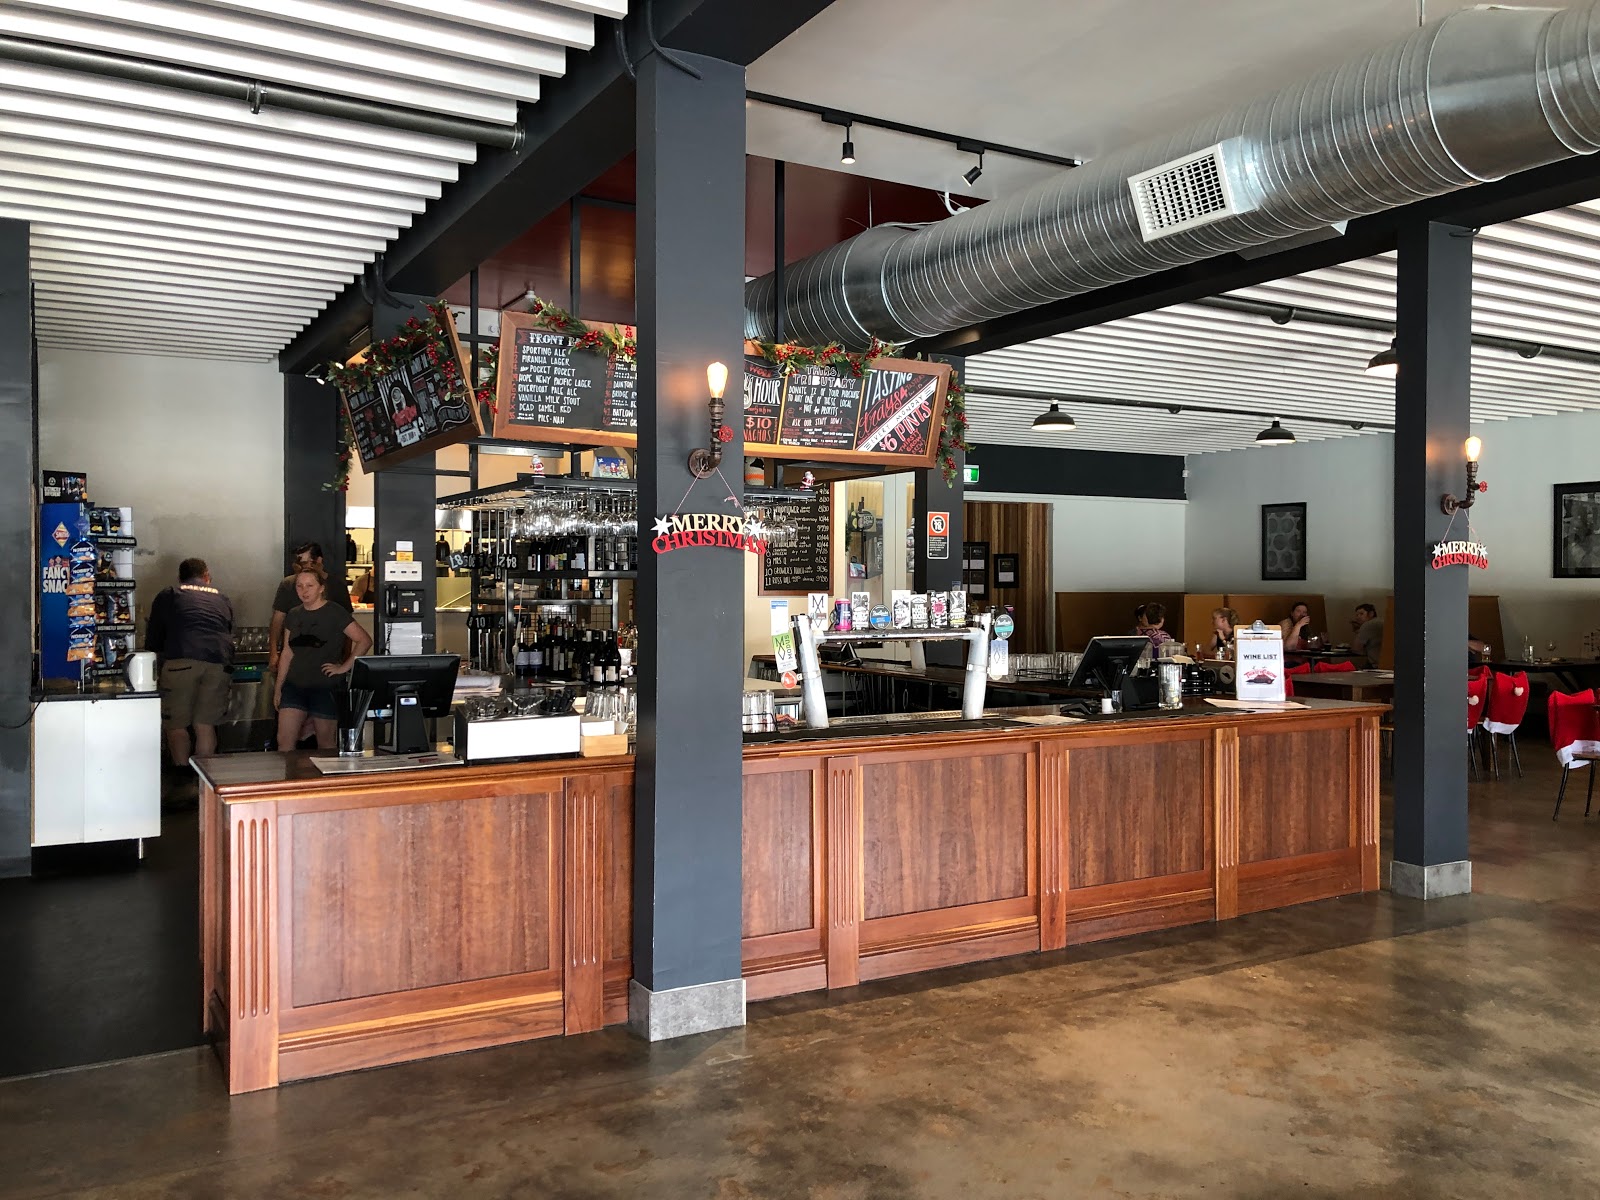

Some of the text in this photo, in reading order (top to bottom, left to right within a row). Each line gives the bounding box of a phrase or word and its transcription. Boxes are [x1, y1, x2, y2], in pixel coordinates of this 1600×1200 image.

[529, 332, 565, 346] FRONT
[522, 345, 552, 357] SPORTING
[554, 348, 567, 358] ALE
[521, 355, 548, 365] PIRANHA
[550, 358, 571, 367] LAGER
[529, 365, 552, 375] POCKET
[553, 367, 577, 378] ROCKET
[553, 377, 573, 387] PACIFIC
[574, 379, 592, 389] LAGER
[793, 373, 857, 390] TRIBUTARY
[551, 386, 564, 396] PALE
[566, 388, 578, 397] ALE
[752, 378, 781, 405] HOUR
[788, 385, 807, 395] DONATE
[828, 388, 840, 398] YOUR
[864, 368, 914, 411] TASTING
[517, 394, 542, 403] VANILLA
[545, 395, 561, 405] MILK
[562, 397, 581, 407] STOUT
[804, 395, 814, 405] ONE
[840, 399, 852, 409] LOCAL
[518, 403, 572, 414] DEAD CAMEL RED
[612, 408, 634, 418] BATLOW
[803, 404, 813, 414] NOT
[745, 416, 772, 429] $10
[791, 418, 802, 427] ASK
[803, 418, 813, 427] OUR
[870, 424, 891, 445] EVERY
[895, 394, 924, 422] MONDAY
[879, 433, 898, 452] $6
[894, 400, 932, 442] PINTS
[743, 428, 772, 442] NACHOS
[669, 513, 750, 535] MERRY
[652, 529, 768, 555] CHRISTMAS
[1441, 541, 1481, 556] MERRY
[766, 557, 772, 568] 9
[1431, 552, 1489, 570] CHRISTMAS
[764, 567, 773, 577] 10
[42, 579, 68, 593] SNAC
[765, 576, 772, 586] 11
[475, 616, 486, 628] 10
[784, 634, 793, 660] MODUS
